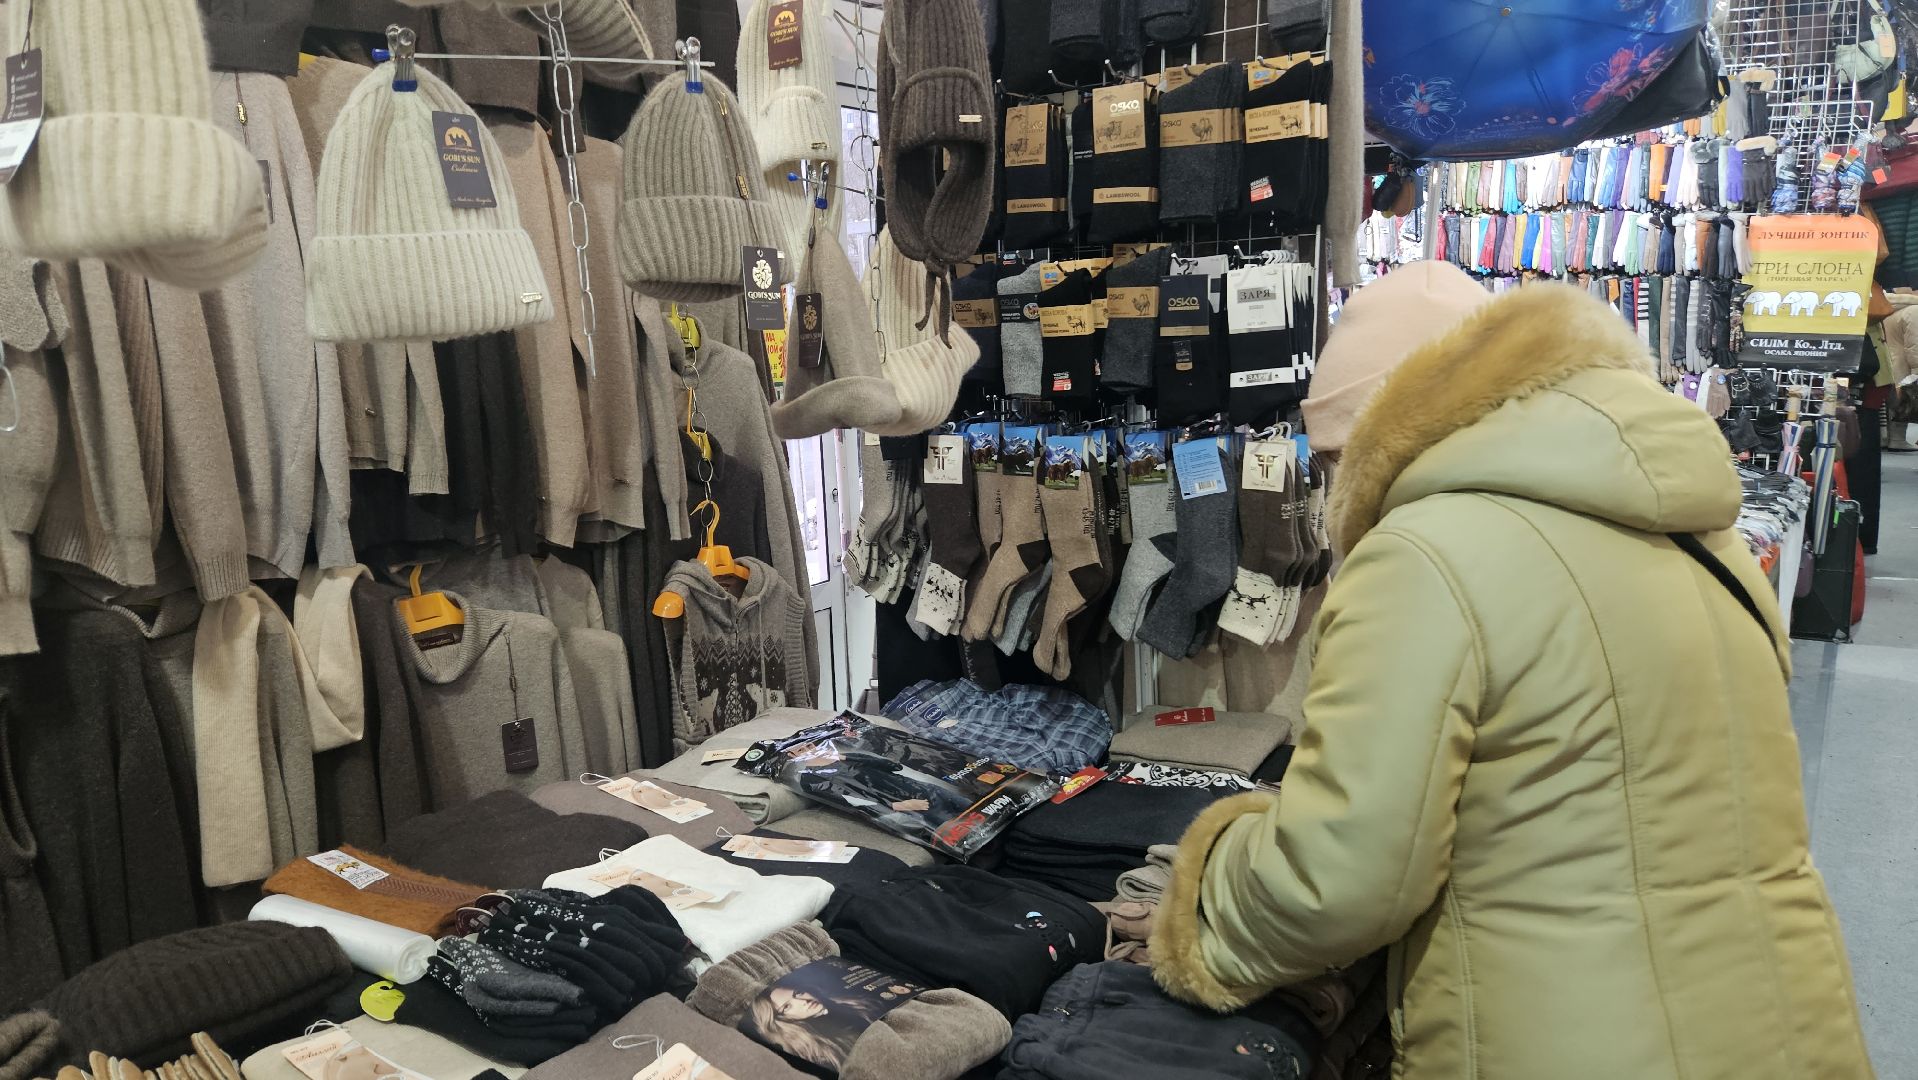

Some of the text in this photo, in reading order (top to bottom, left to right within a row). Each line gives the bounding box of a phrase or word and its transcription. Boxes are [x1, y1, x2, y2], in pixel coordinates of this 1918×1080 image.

[1109, 99, 1140, 113] OSKO
[443, 153, 481, 164] GOBI'S SUN
[1758, 229, 1870, 240] ЛУЧШИЙ ЗОНТИК
[1752, 262, 1864, 275] ТРИ СЛОНА
[1240, 289, 1271, 301] ЗАРЯ
[1168, 296, 1199, 307] OSKO
[1750, 338, 1845, 351] СИЛМ Ко., Лтд.
[980, 794, 1013, 816] WARM
